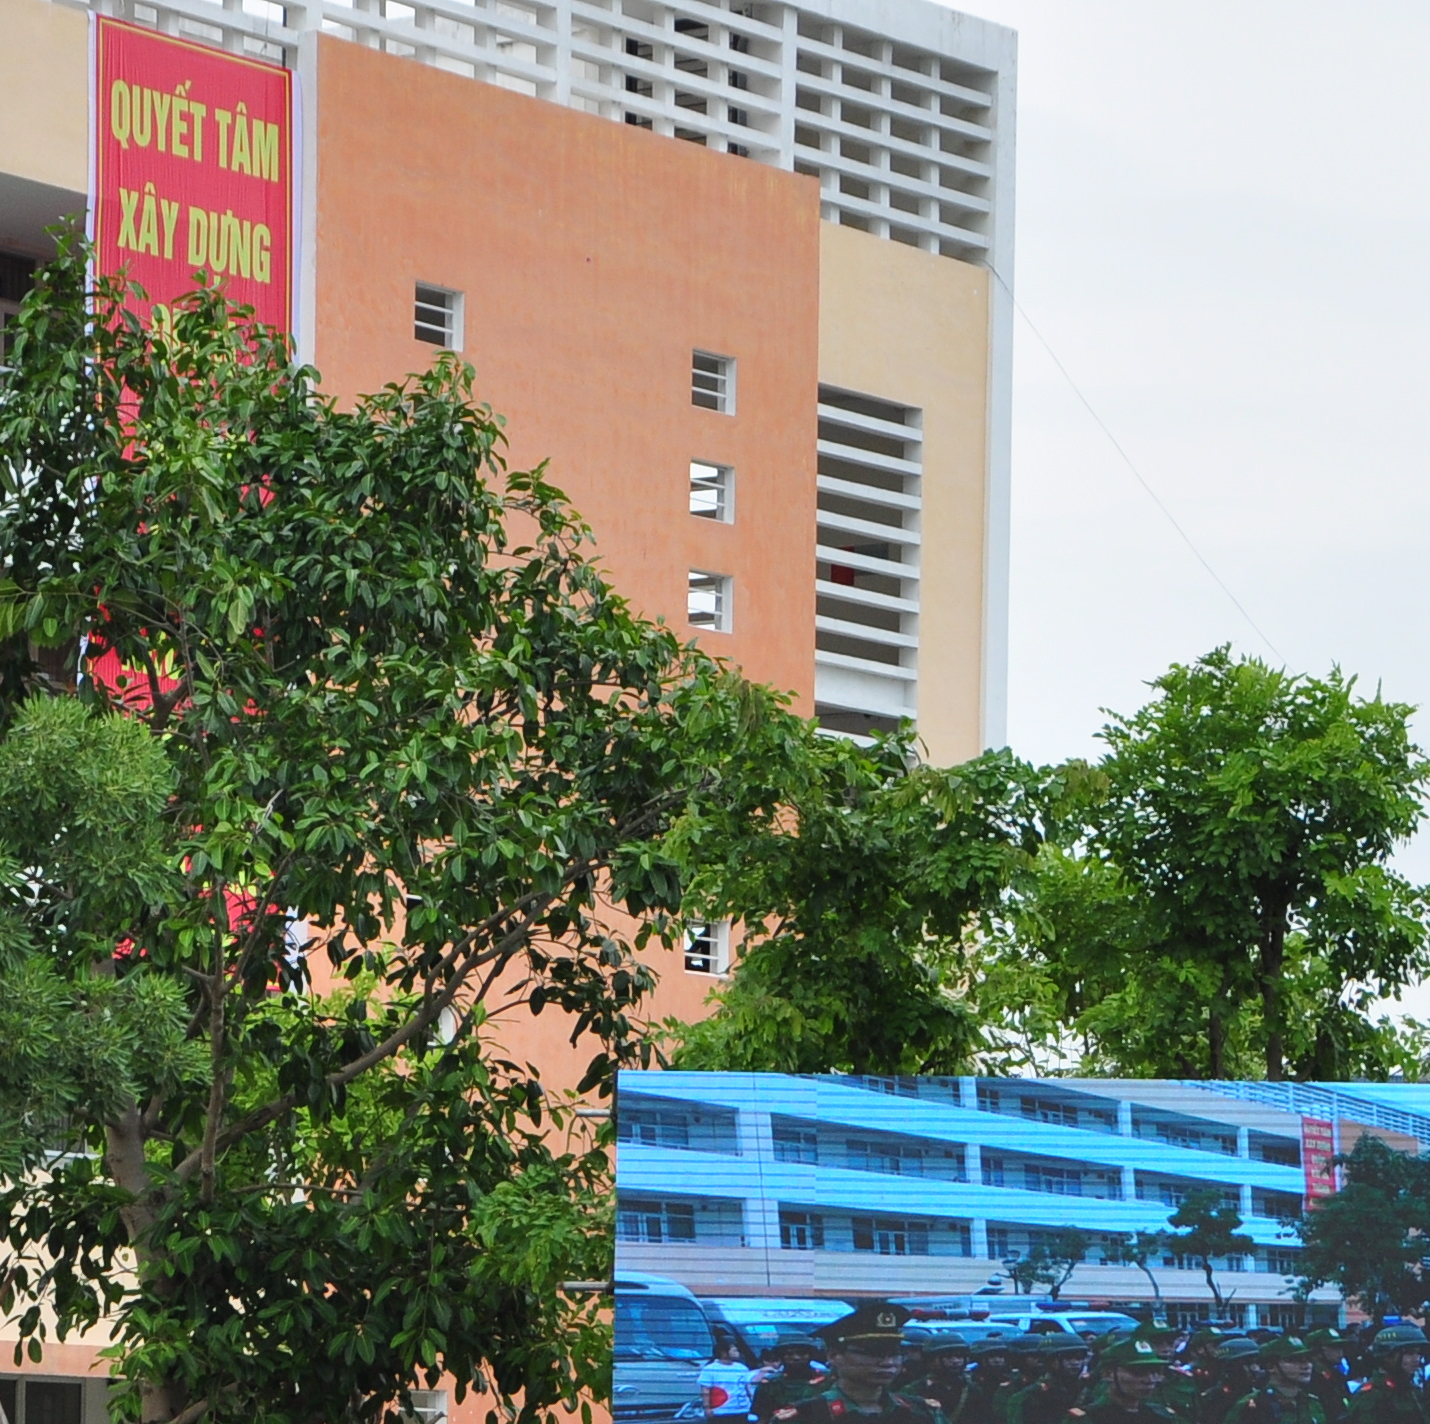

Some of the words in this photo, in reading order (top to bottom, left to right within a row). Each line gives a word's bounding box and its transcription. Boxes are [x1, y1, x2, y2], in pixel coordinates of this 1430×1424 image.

[111, 79, 206, 163] QUYẾT
[215, 101, 279, 183] TÂM
[117, 181, 179, 260] XÂY
[188, 205, 271, 286] DỰNG
